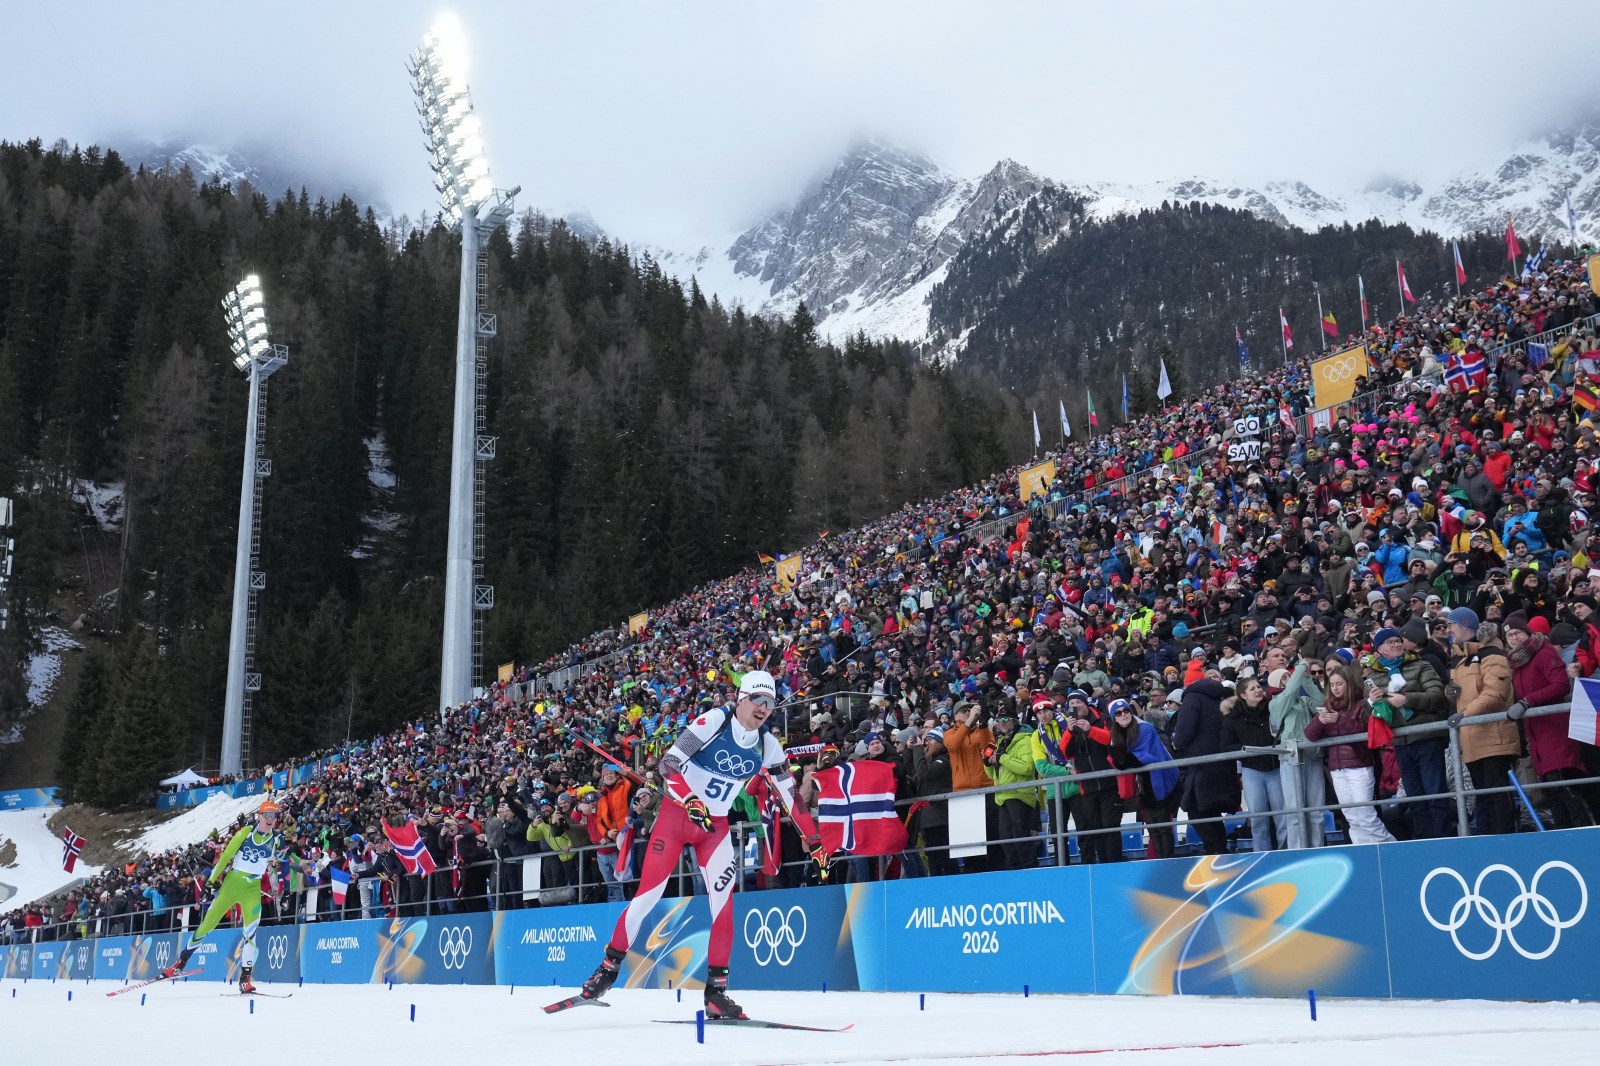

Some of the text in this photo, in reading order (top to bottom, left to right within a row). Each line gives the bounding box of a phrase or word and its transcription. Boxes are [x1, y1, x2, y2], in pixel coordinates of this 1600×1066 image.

[1235, 420, 1258, 434] GO
[1229, 445, 1260, 458] SAM
[704, 777, 735, 802] 51
[241, 849, 260, 864] 53
[905, 900, 1065, 929] MILANO CORTINA
[315, 936, 360, 950] MILANO CORTINA
[520, 925, 597, 944] MILANO CORTINA
[962, 930, 999, 954] 2026
[547, 945, 566, 962] 2026
